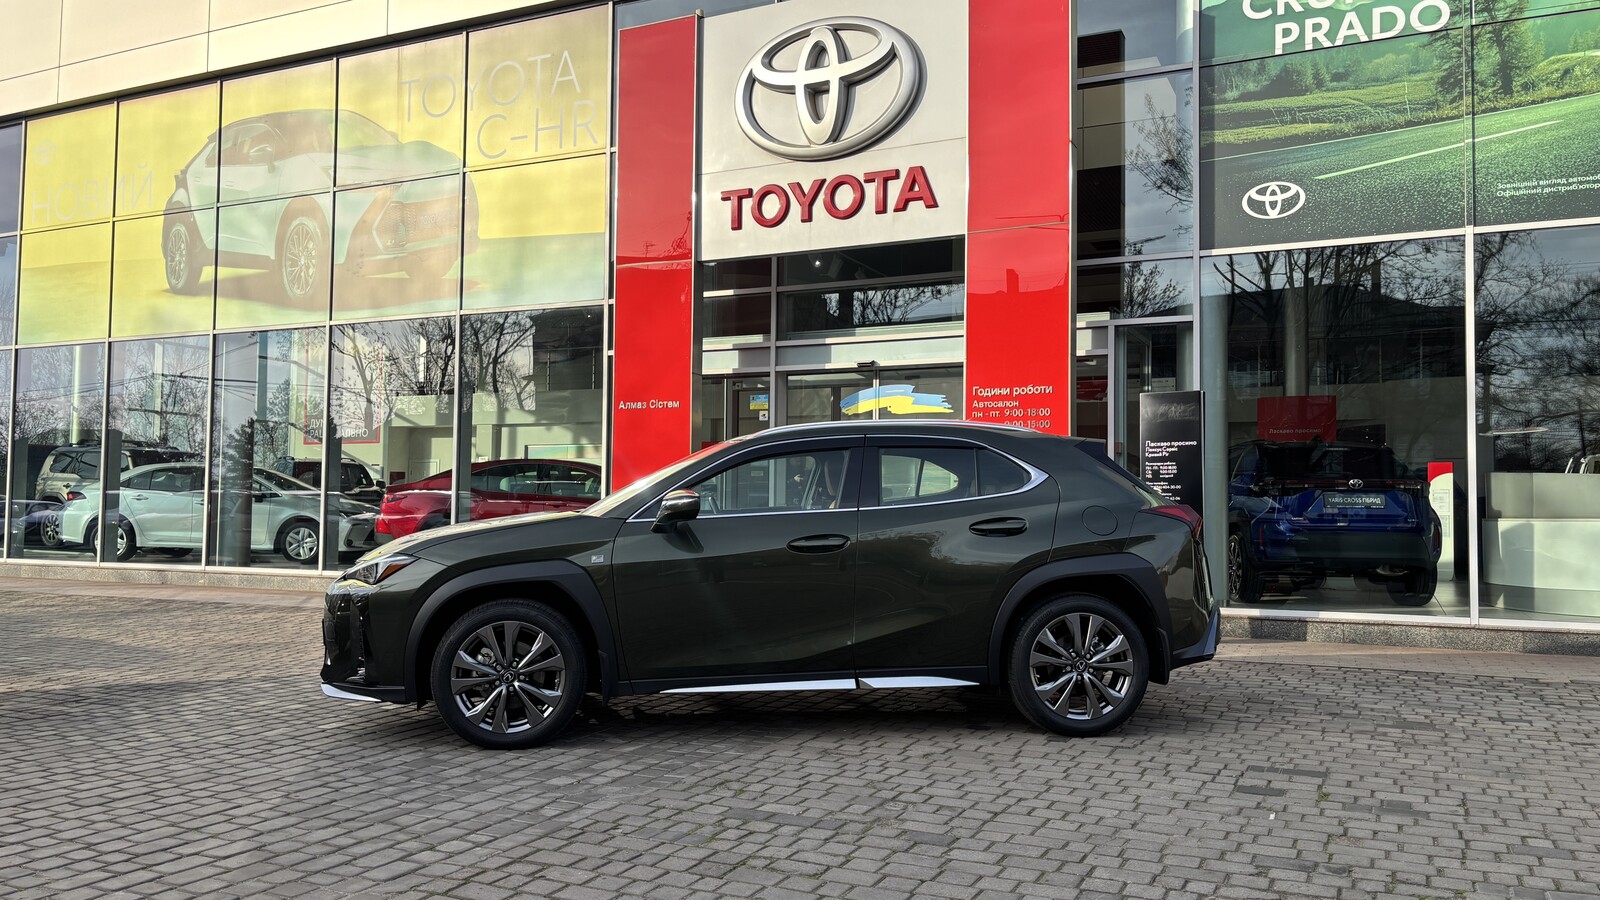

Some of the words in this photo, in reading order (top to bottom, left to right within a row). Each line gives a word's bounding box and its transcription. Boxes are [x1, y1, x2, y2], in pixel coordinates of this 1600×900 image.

[1274, 0, 1451, 55] PRADO
[401, 50, 581, 122] TOYOTA
[477, 100, 598, 159] C-HR
[31, 162, 153, 224] НОВИЙ
[721, 165, 938, 231] TOYOTA
[1497, 187, 1542, 197] Офіційний
[1539, 178, 1567, 186] вигляд
[618, 400, 647, 410] Алмаз
[649, 399, 680, 409] Сістем
[972, 386, 1010, 397] Години
[1013, 384, 1053, 397] роботи
[972, 400, 1019, 408] Автосалон
